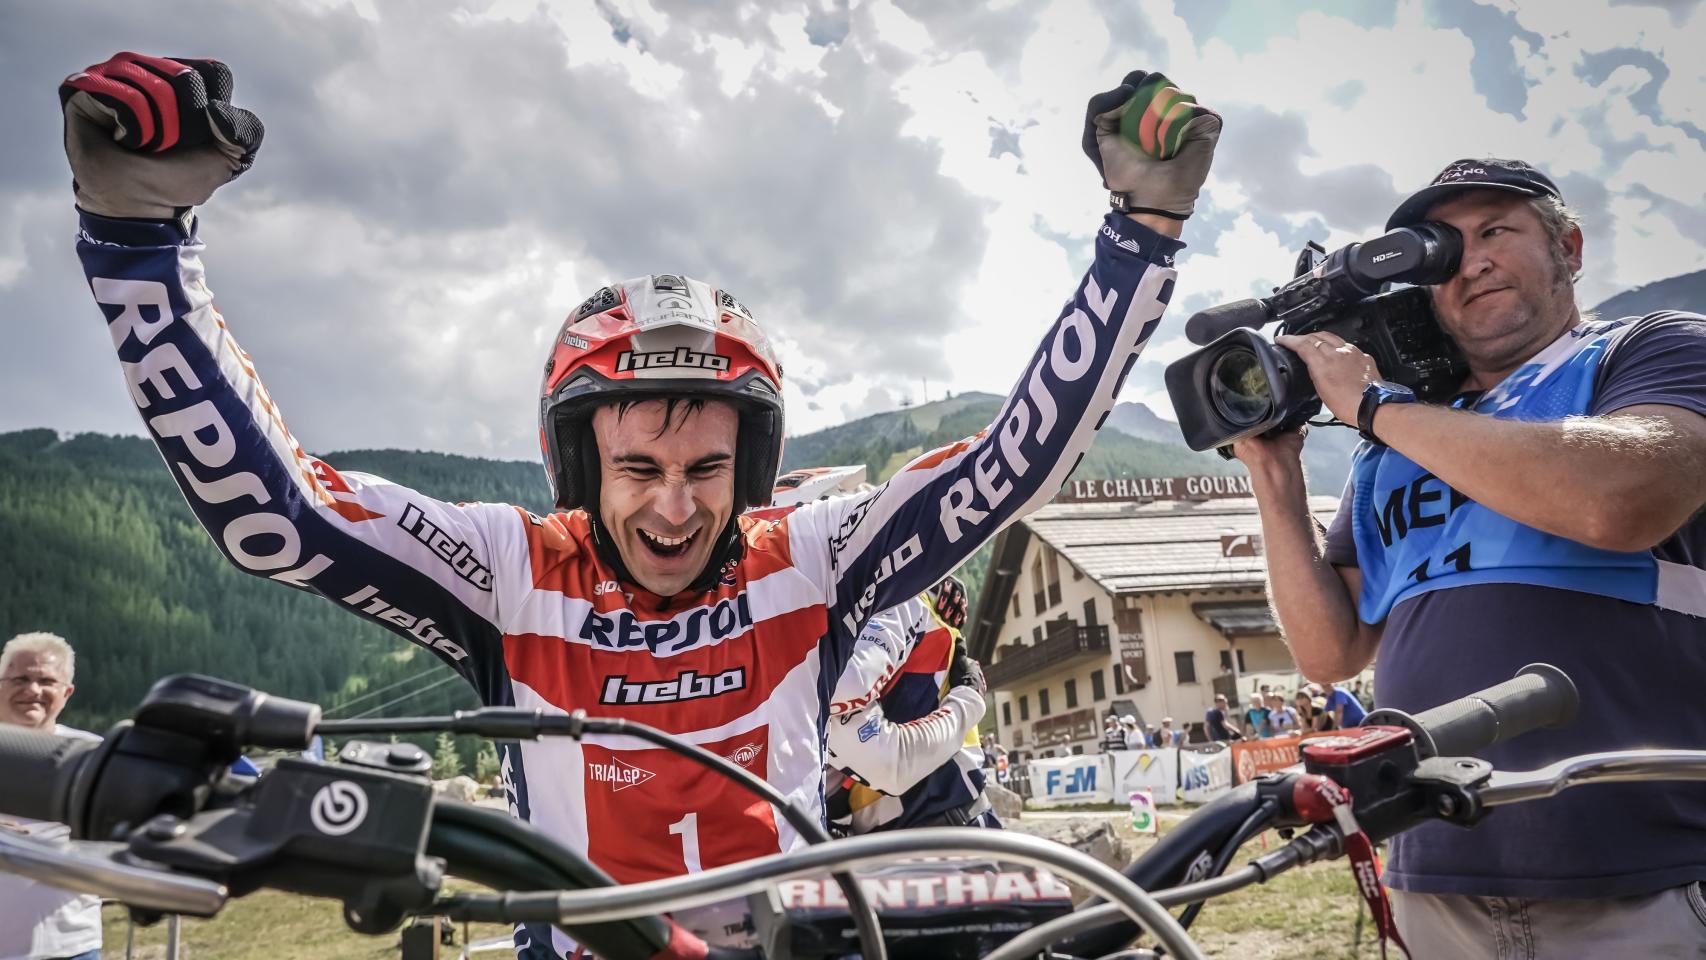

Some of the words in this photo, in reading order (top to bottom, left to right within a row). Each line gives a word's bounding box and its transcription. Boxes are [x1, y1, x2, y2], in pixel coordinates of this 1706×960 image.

[563, 332, 588, 350] hebo
[614, 346, 731, 374] hebo
[92, 277, 335, 587] REPSOL
[940, 273, 1119, 544] REPSOL
[1074, 480, 1098, 499] LE
[1103, 478, 1174, 498] CHALET
[397, 502, 493, 592] hebo
[342, 584, 469, 661] hebo
[579, 593, 753, 654] REPSOL
[599, 666, 746, 706] hebo
[588, 762, 641, 784] TRIALGP
[736, 751, 754, 762] FIM
[669, 812, 703, 875] 1
